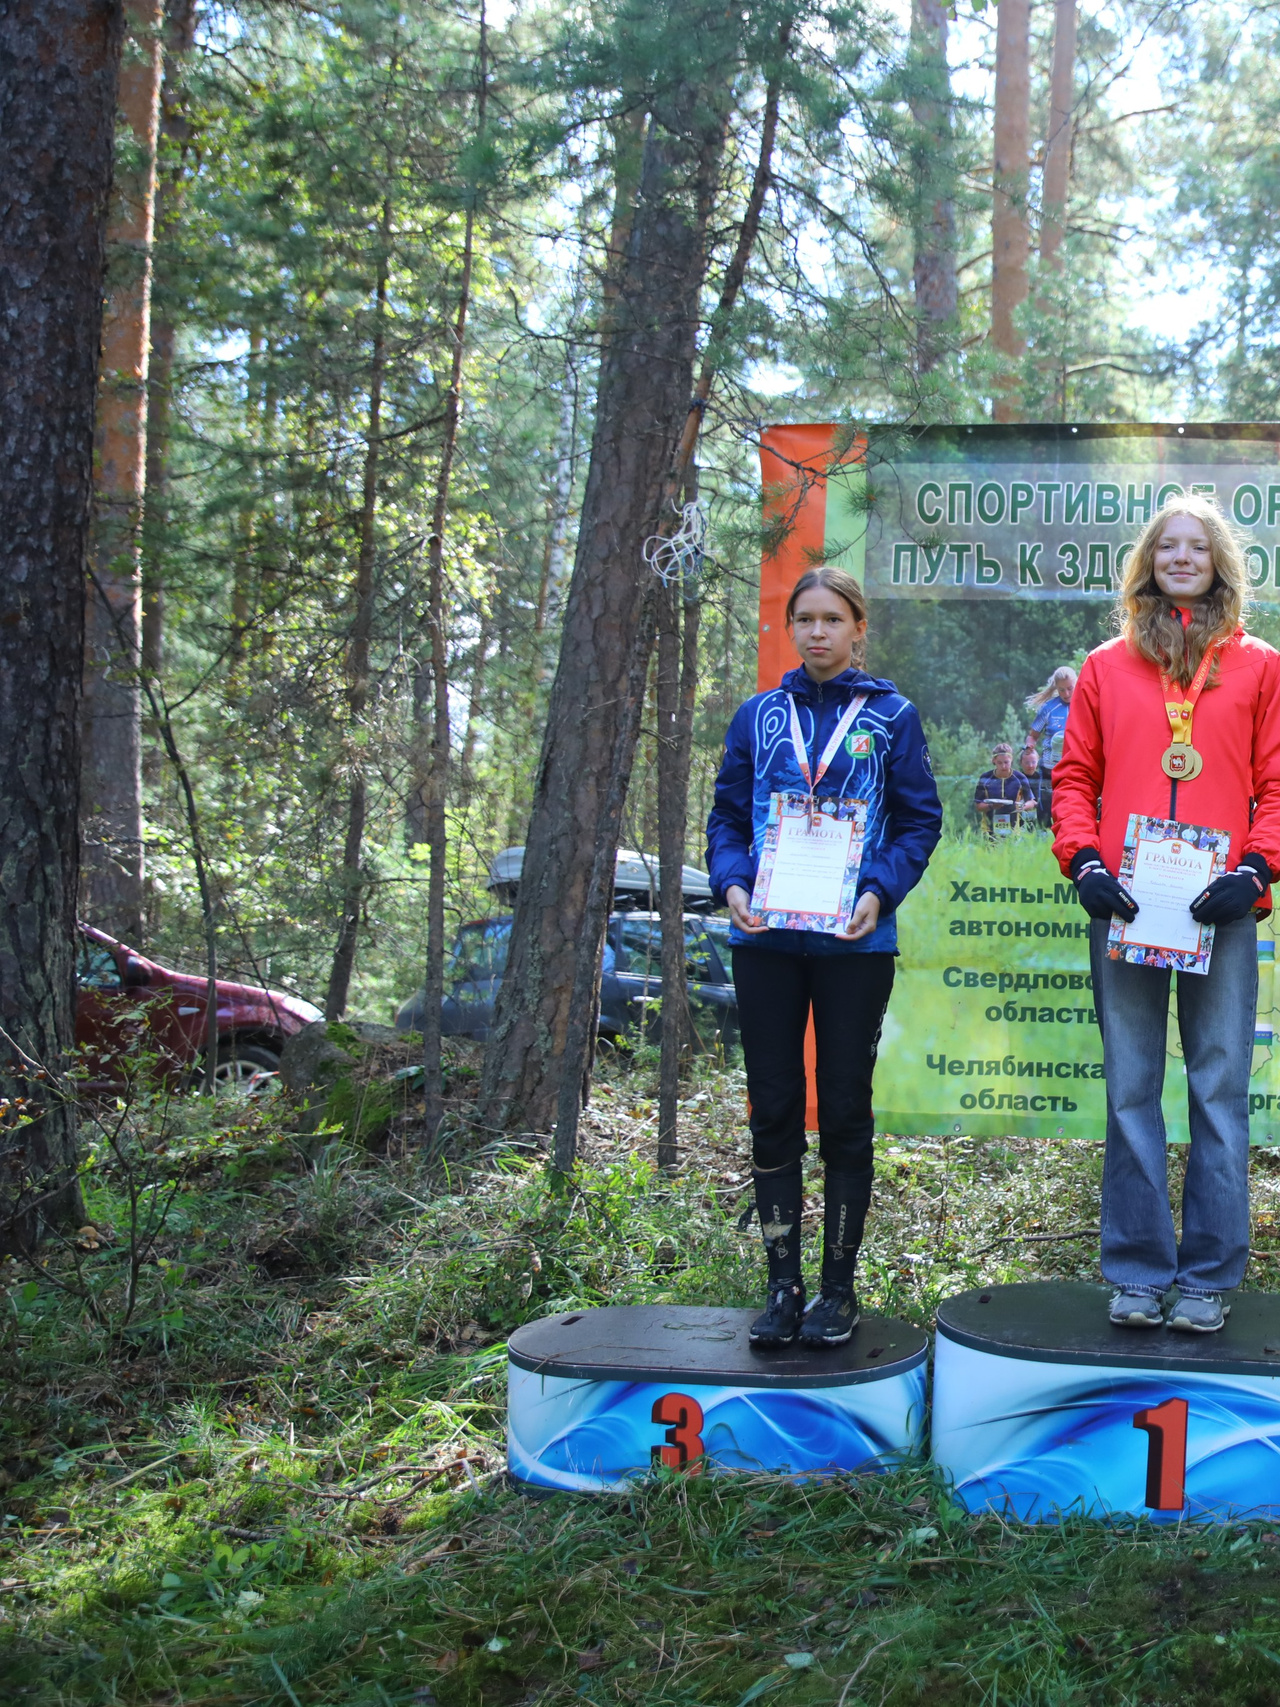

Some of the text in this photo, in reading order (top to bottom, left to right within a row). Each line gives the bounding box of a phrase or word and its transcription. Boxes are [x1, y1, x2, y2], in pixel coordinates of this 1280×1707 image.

[891, 543, 1002, 586] ПУТЬ
[1018, 543, 1044, 587] К
[788, 827, 843, 840] ГРАМОТА
[1145, 852, 1203, 871] ГРАМОТА
[959, 1087, 1078, 1113] область
[650, 1391, 705, 1476] 3
[1132, 1397, 1189, 1511] 1
